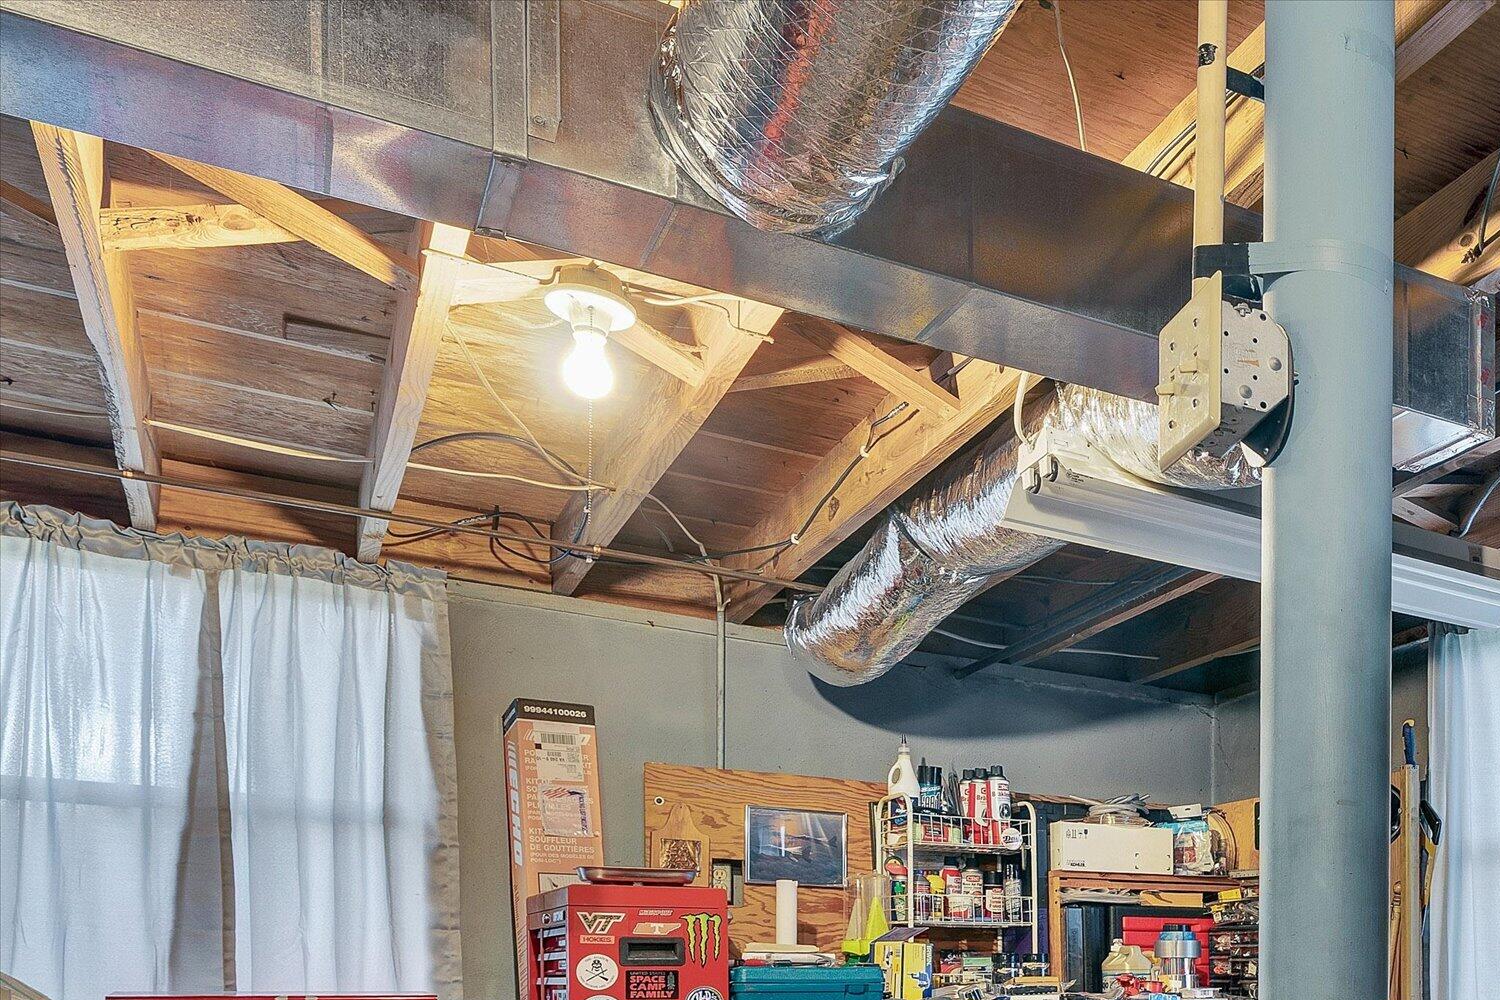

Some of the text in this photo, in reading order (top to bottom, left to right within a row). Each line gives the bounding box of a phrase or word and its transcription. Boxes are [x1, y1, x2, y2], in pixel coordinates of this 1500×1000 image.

[523, 705, 587, 719] 99944100026
[576, 911, 627, 935] VT
[629, 975, 666, 983] SPACE
[629, 983, 666, 991] CAMP
[630, 990, 675, 999] FAMILY
